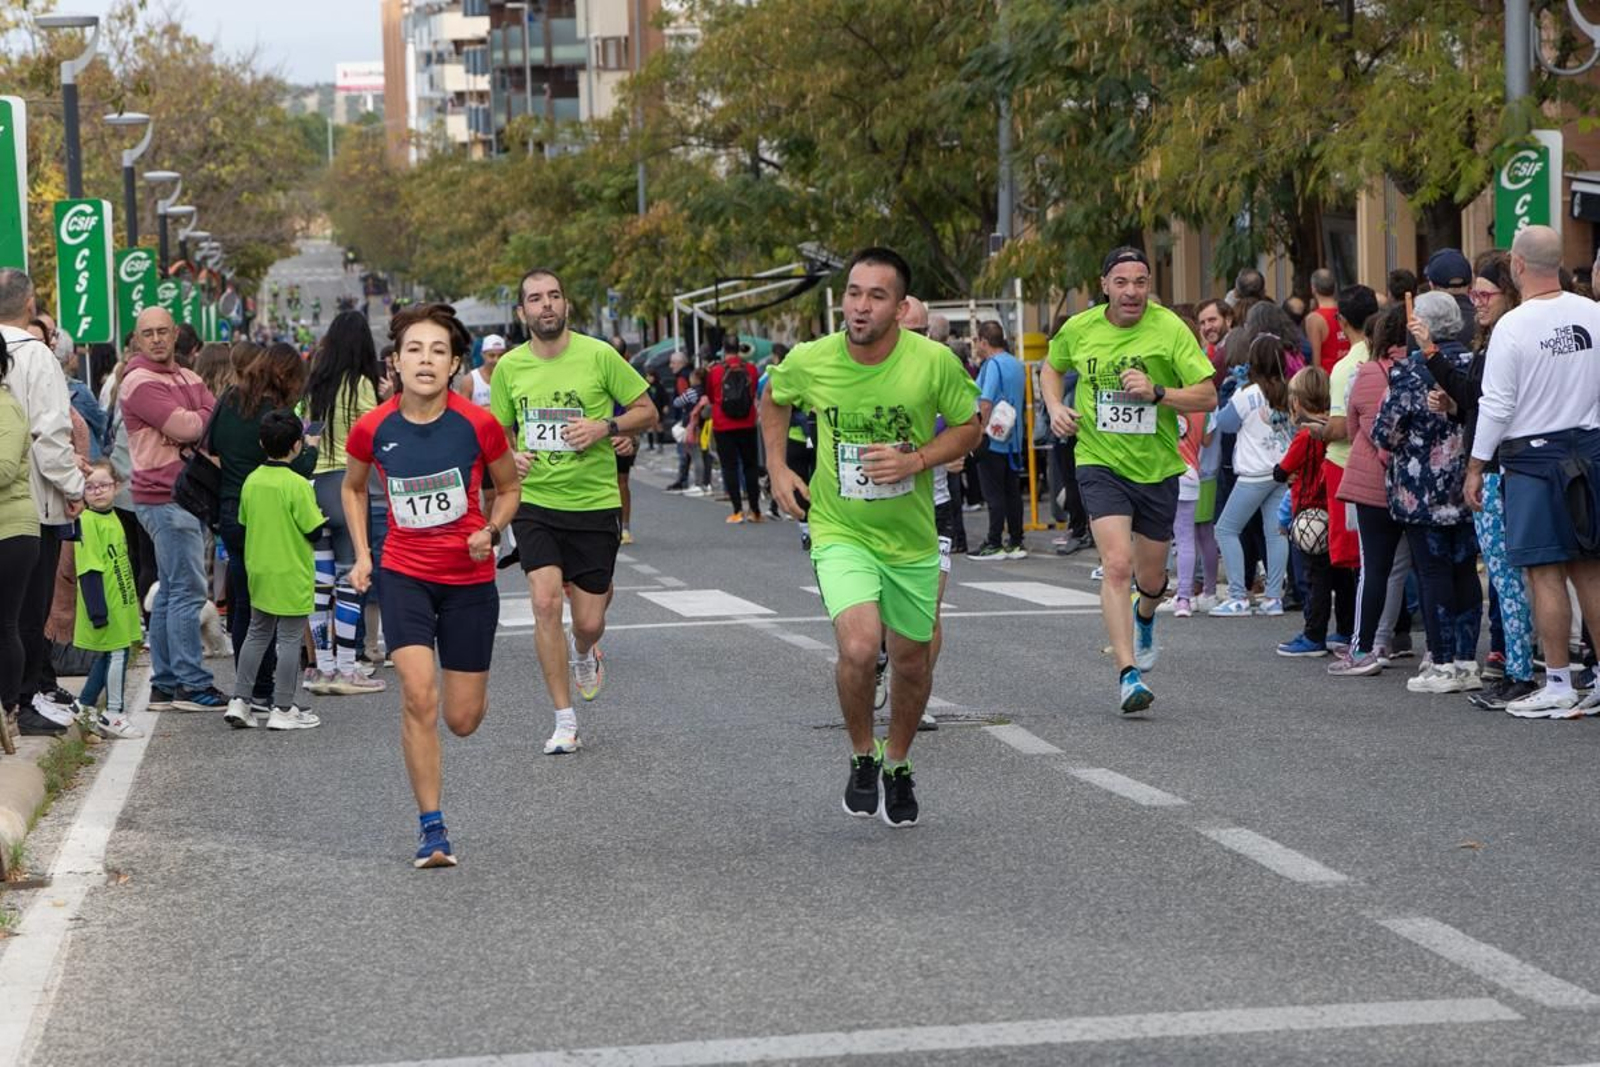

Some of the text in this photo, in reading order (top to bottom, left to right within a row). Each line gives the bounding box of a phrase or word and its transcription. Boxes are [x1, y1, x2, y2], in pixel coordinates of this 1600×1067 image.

[68, 216, 99, 231] CSIF
[75, 248, 92, 338] CSIF
[1554, 325, 1572, 336] THE
[1540, 335, 1574, 350] NORTH
[1552, 344, 1575, 356] FACE
[1087, 358, 1097, 374] 17
[824, 406, 838, 428] 17
[1109, 406, 1145, 423] 351
[844, 447, 858, 460] XI
[406, 492, 451, 516] 178
